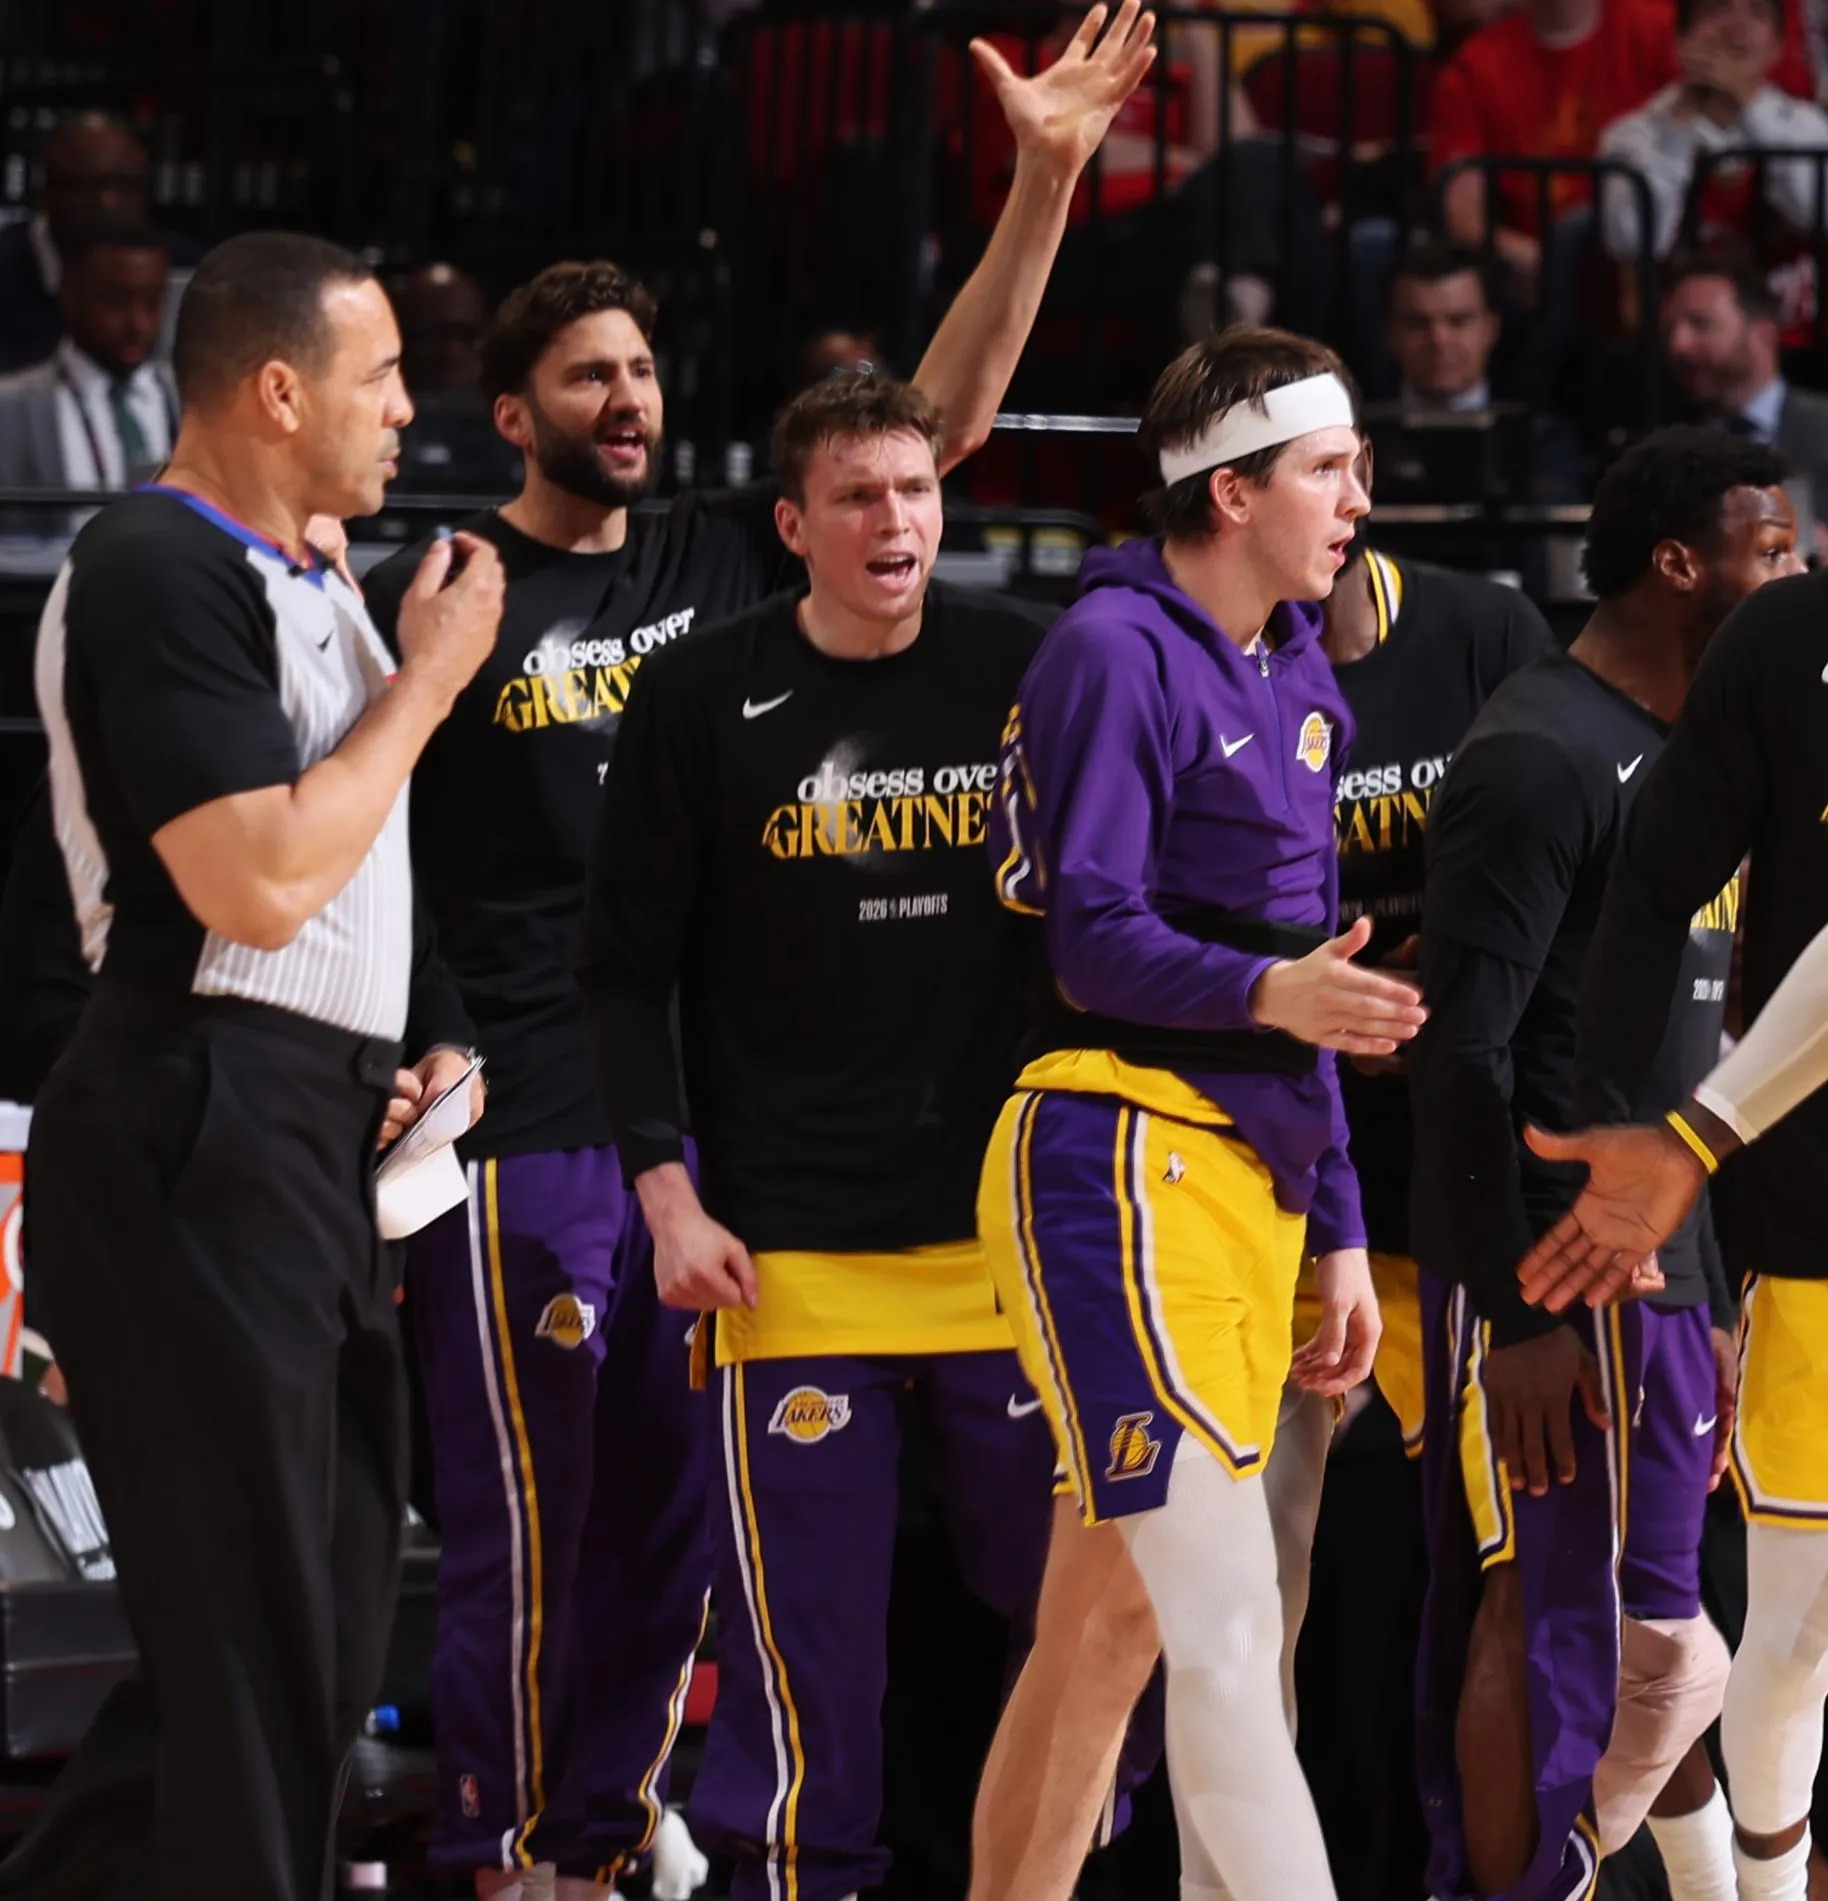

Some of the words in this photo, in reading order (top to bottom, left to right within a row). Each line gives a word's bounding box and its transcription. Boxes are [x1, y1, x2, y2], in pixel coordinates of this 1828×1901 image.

[523, 637, 626, 675] obsess
[630, 607, 695, 654] over
[797, 761, 925, 802] obsess
[762, 791, 994, 860] GREATNE
[858, 899, 888, 921] 2026
[899, 894, 949, 919] PLAYOFFS
[767, 1396, 852, 1435] LAKERS
